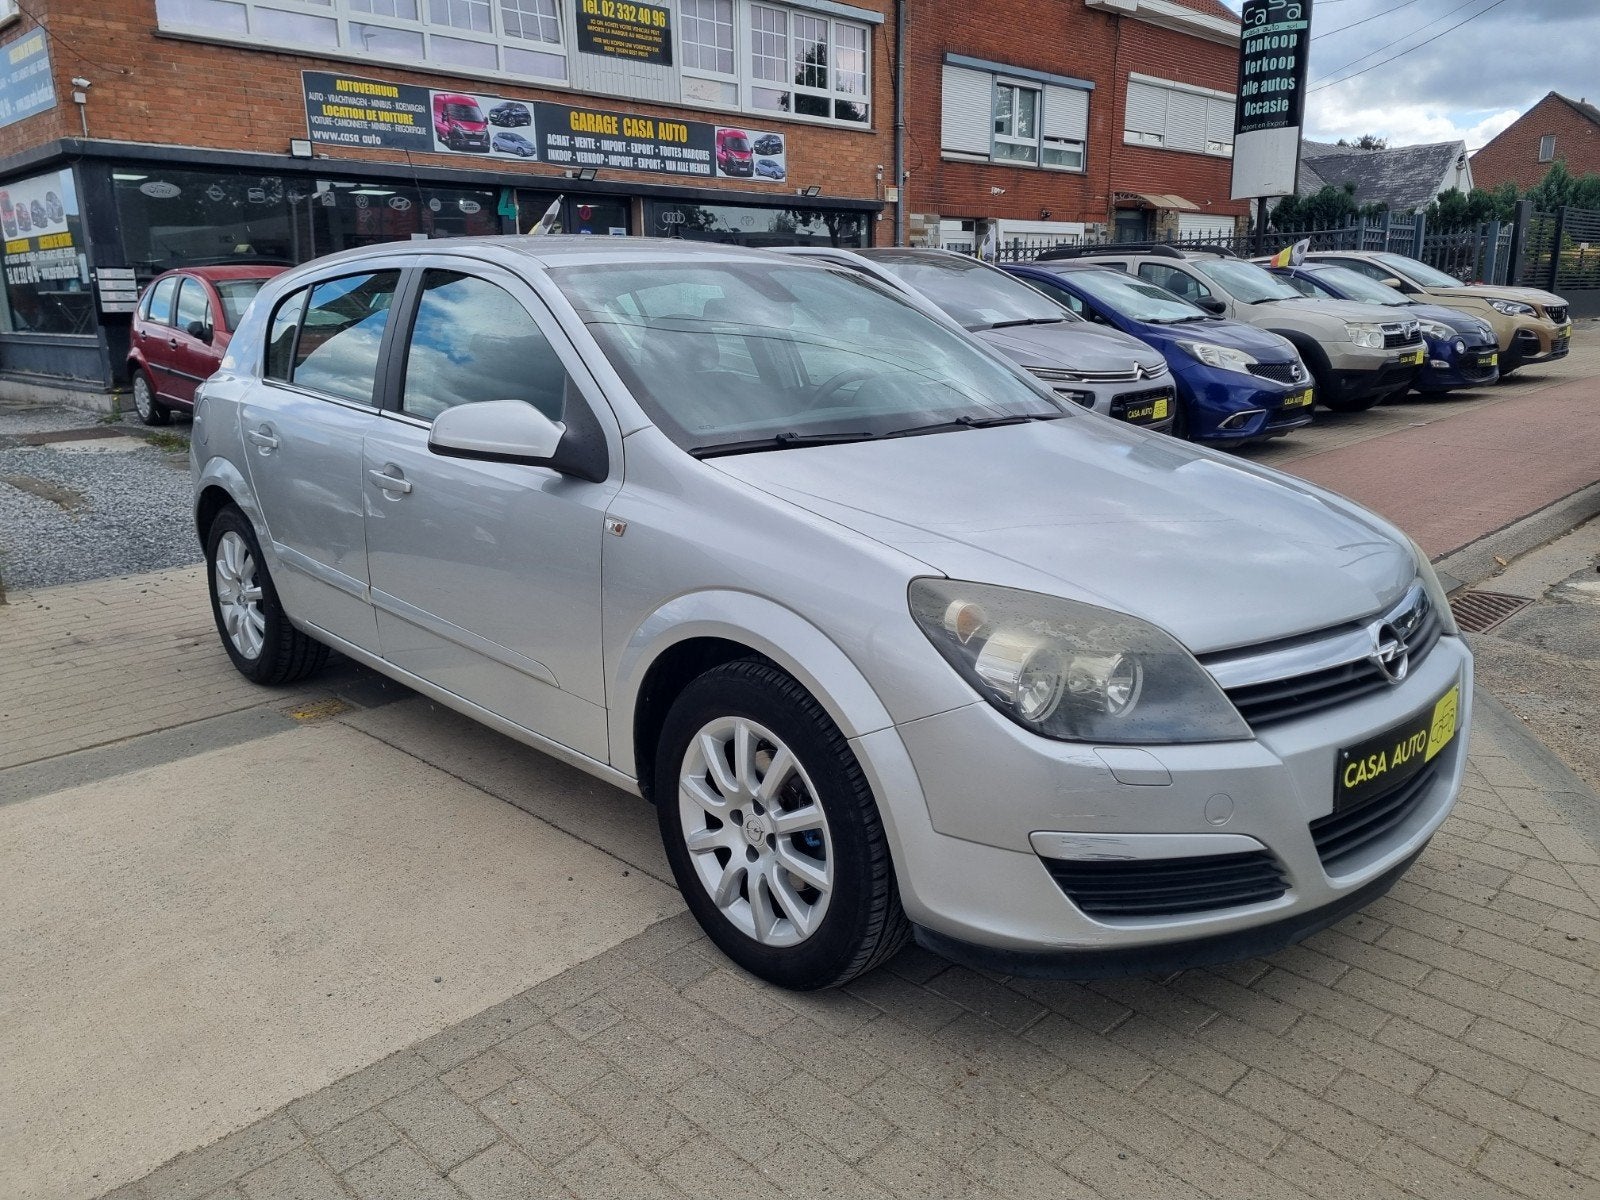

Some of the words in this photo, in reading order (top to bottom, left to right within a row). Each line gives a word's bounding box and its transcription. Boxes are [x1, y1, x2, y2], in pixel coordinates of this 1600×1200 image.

[602, 1, 615, 18] 02
[617, 3, 636, 22] 332
[638, 7, 650, 25] 40
[652, 10, 665, 27] 96
[1245, 34, 1298, 54] Aankoop
[1245, 56, 1296, 76] Verkoop
[336, 80, 398, 98] AUTOVERHUUR
[1242, 80, 1258, 97] alle
[1260, 77, 1295, 93] autos
[308, 92, 324, 100] AUTO
[328, 94, 367, 106] VRACHTWAGEN
[371, 99, 391, 109] MINIBUS
[396, 101, 425, 113] KOELWAGEN
[1244, 97, 1289, 117] Occasie
[322, 105, 364, 119] LOCATION
[366, 110, 377, 121] DE
[379, 111, 413, 125] VOITURE
[312, 130, 359, 142] www.casa
[362, 134, 381, 144] auto
[371, 122, 391, 132] MINIBUS
[570, 111, 618, 135] GARAGE
[623, 117, 654, 138] CASA
[659, 122, 688, 143] AUTO
[547, 134, 570, 147] ACHAT
[575, 137, 595, 149] VENTE
[601, 140, 626, 153] IMPORT
[631, 142, 654, 155] EXPORT
[659, 145, 681, 158] TOUTES
[682, 149, 710, 161] MARQUES
[548, 149, 571, 162] INKOOP
[576, 152, 605, 165] VERKOOP
[609, 155, 633, 167] IMPORT
[638, 158, 660, 170] EXPORT
[666, 160, 676, 171] VAN
[677, 161, 689, 172] ALLE
[690, 163, 710, 174] MERKEN
[150, 184, 171, 194] Ford
[1128, 408, 1140, 419] CASA
[1140, 406, 1153, 416] AUTO
[1344, 751, 1387, 788] CASA
[1391, 730, 1426, 769] AUTO
